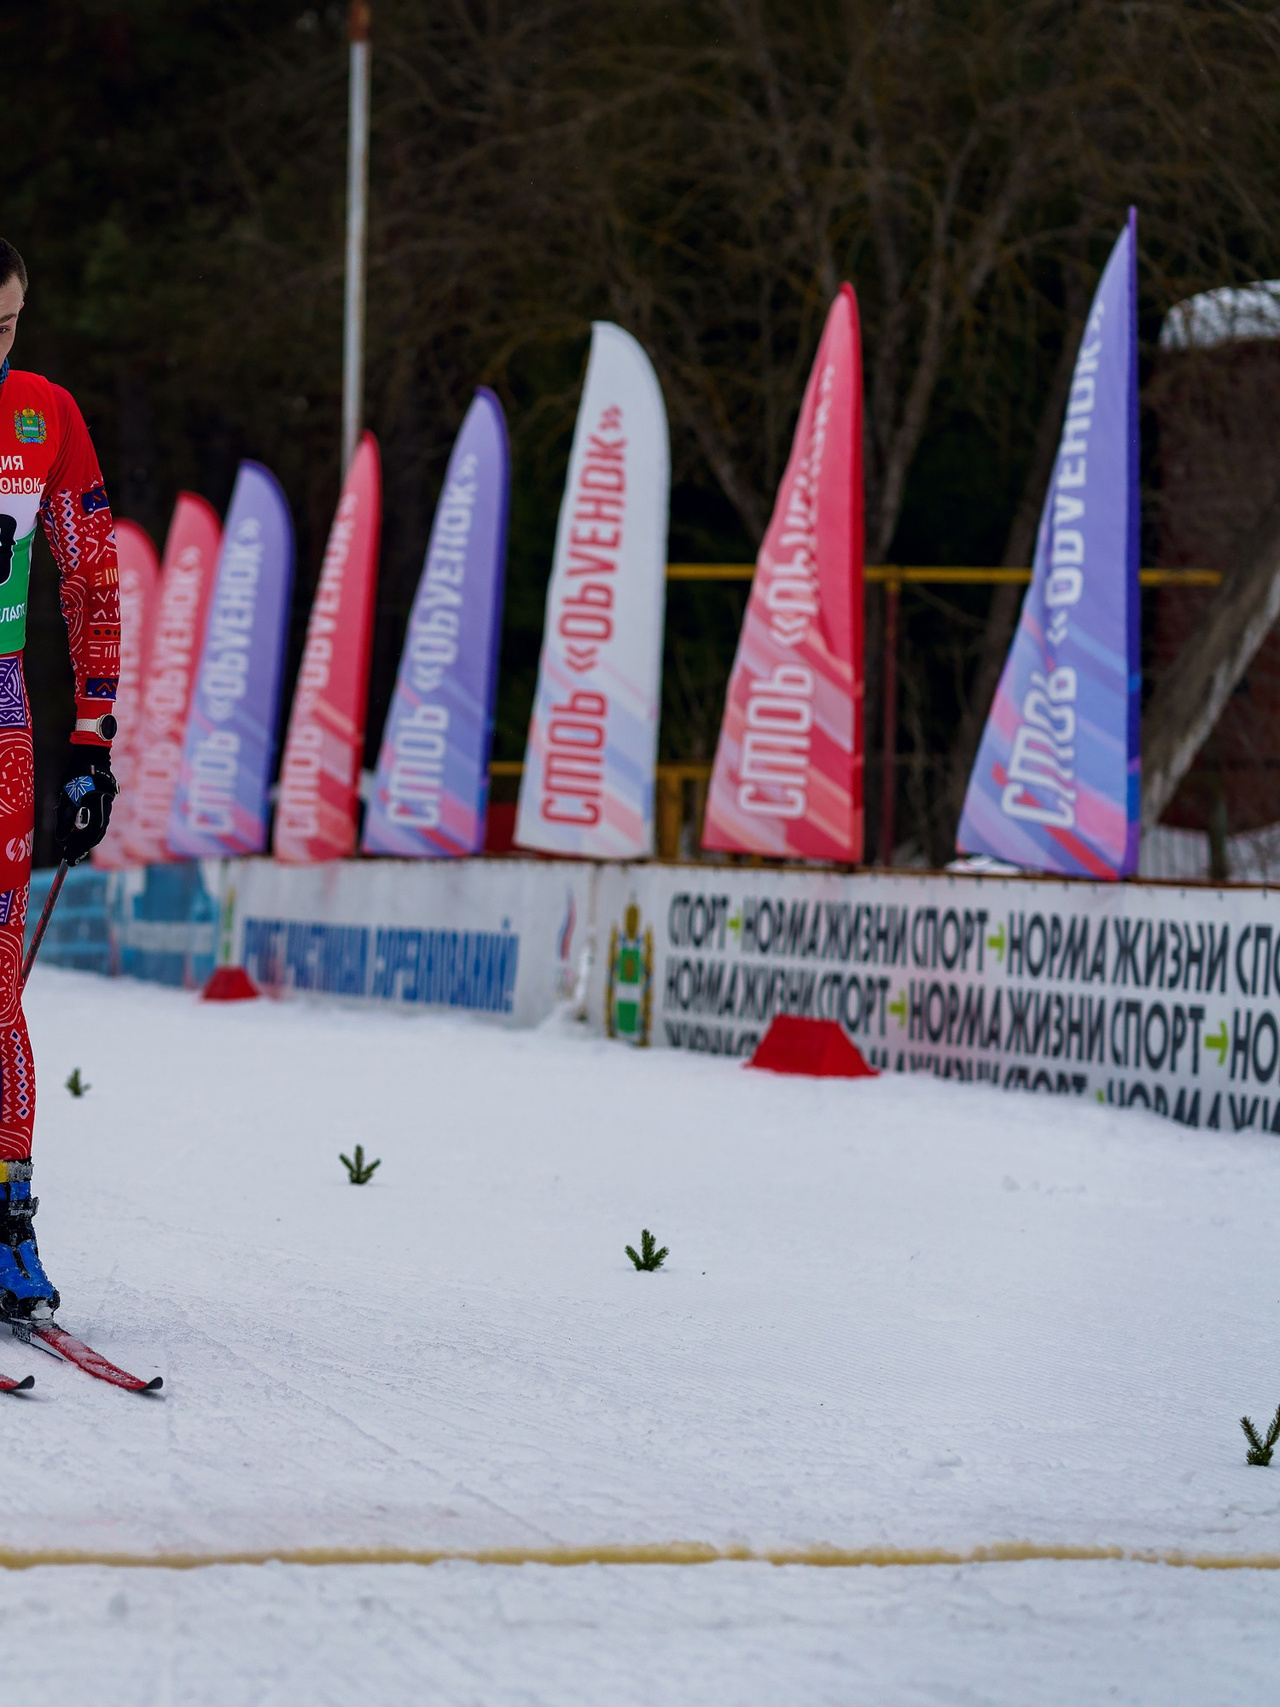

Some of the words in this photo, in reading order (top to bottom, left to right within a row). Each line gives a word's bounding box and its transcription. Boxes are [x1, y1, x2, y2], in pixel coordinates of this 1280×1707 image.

[669, 892, 728, 950] СПОРТ
[911, 905, 988, 975] СПОРТ
[1006, 909, 1108, 984] НОРМА
[1111, 915, 1230, 995] ЖИЗНИ
[909, 978, 1003, 1050] НОРМА
[1004, 986, 1106, 1065] ЖИЗНИ
[1110, 998, 1206, 1076] СПОРТ
